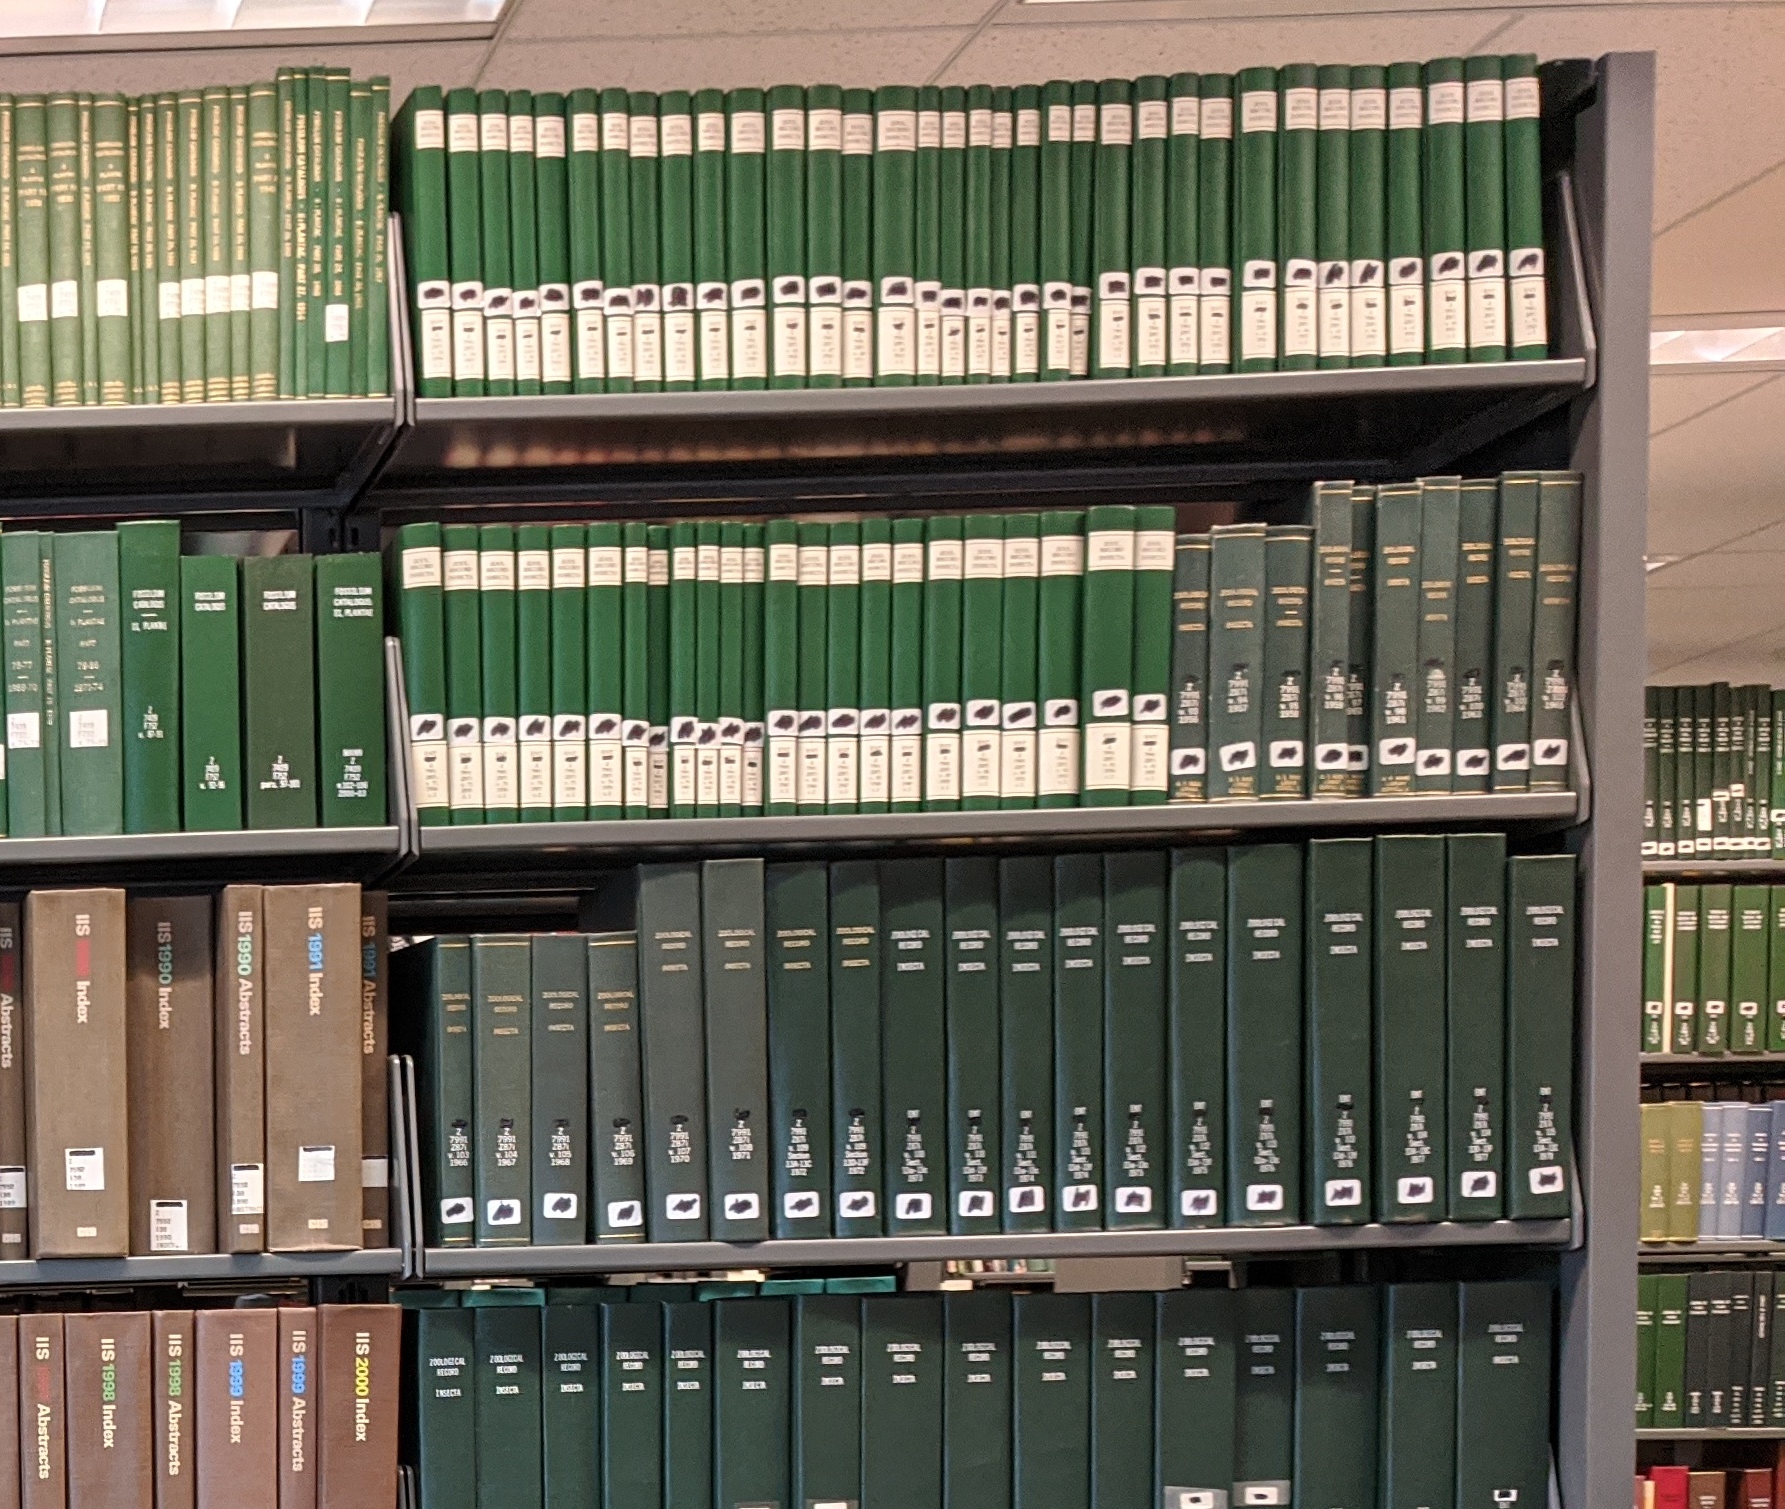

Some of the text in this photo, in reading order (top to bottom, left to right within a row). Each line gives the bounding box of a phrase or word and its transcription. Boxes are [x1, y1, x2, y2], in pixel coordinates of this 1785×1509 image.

[237, 910, 253, 1056] IIS 1990 Abstracts
[307, 906, 323, 1016] IIS 1991 Index
[100, 1338, 117, 1449] IIS 1998 Index
[228, 1332, 246, 1444] IIS 1999 Index
[291, 1329, 308, 1472] IIS 1999 Abstracts
[354, 1332, 371, 1443] IIS 2000 Index
